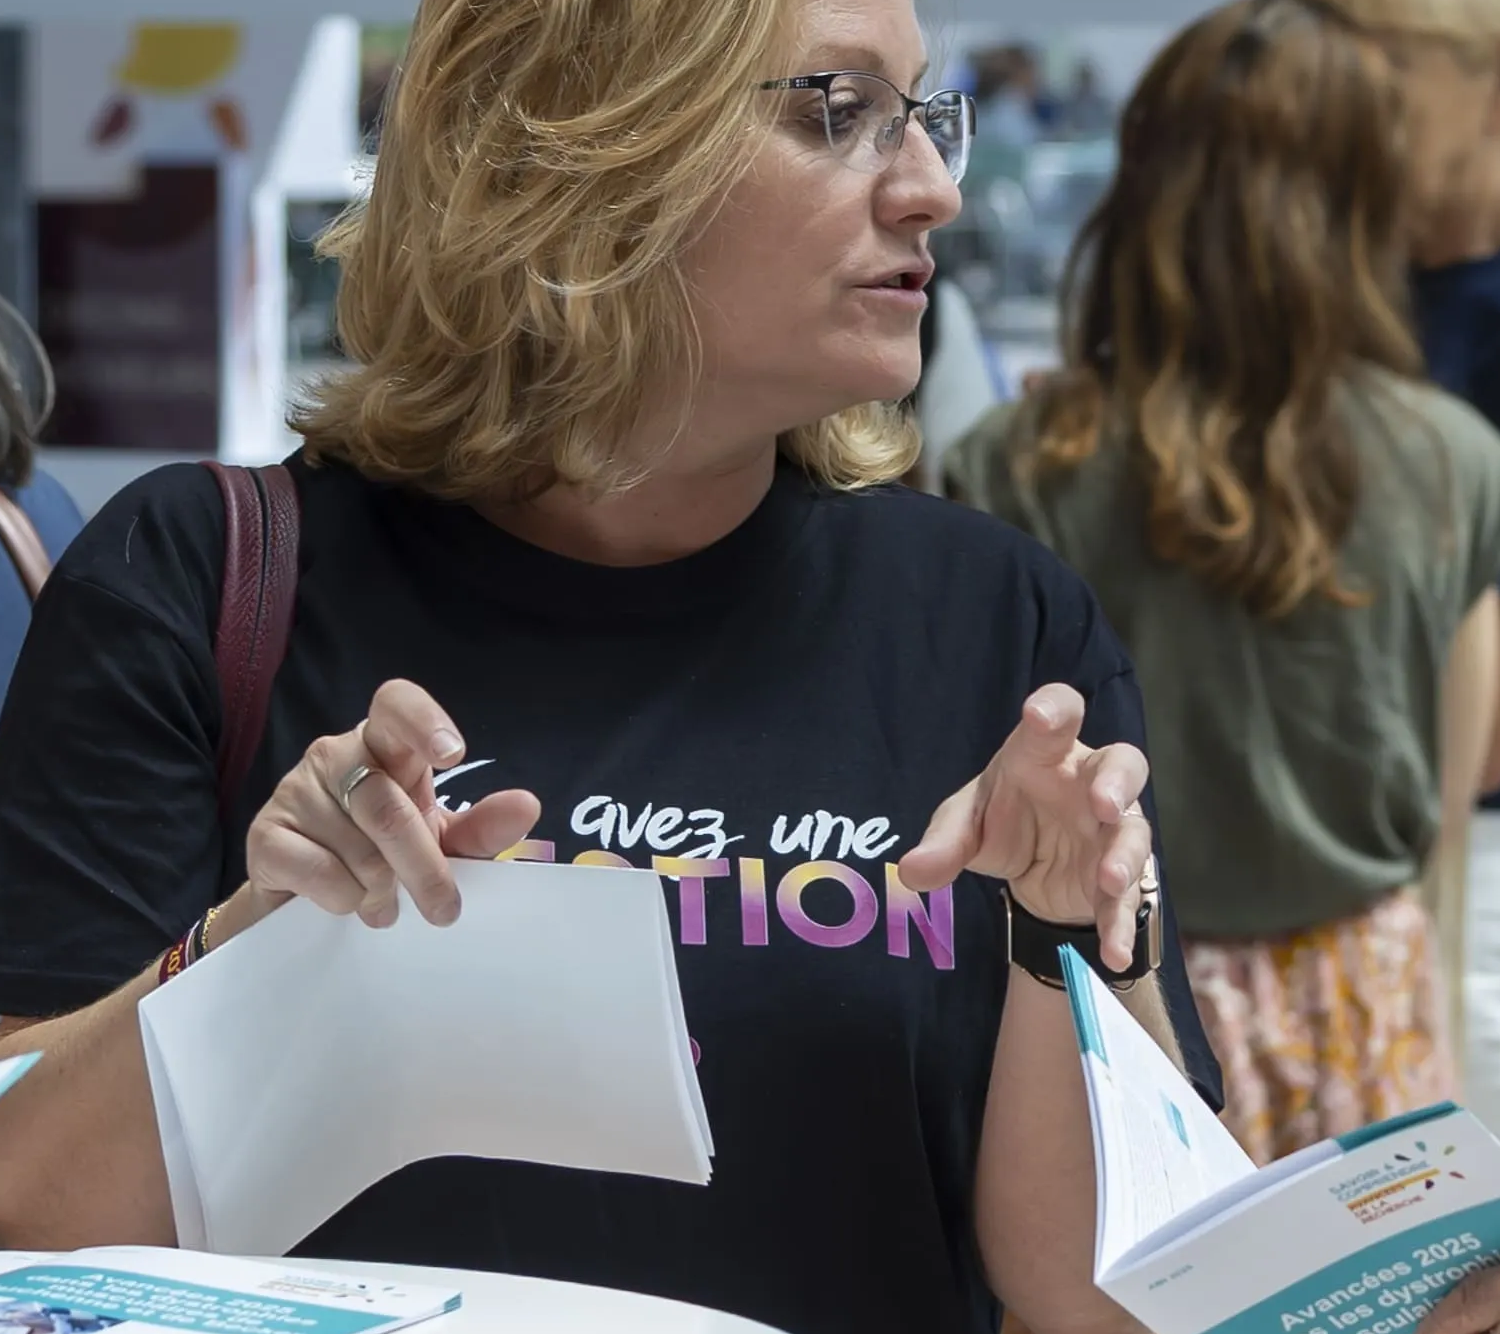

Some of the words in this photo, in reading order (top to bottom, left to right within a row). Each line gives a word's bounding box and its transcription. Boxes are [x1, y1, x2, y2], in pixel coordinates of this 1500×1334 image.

[570, 794, 746, 881] avez
[771, 809, 901, 860] une
[1280, 1261, 1412, 1332] Avancées
[1412, 1232, 1482, 1268] 2025
[1327, 1302, 1374, 1330] les
